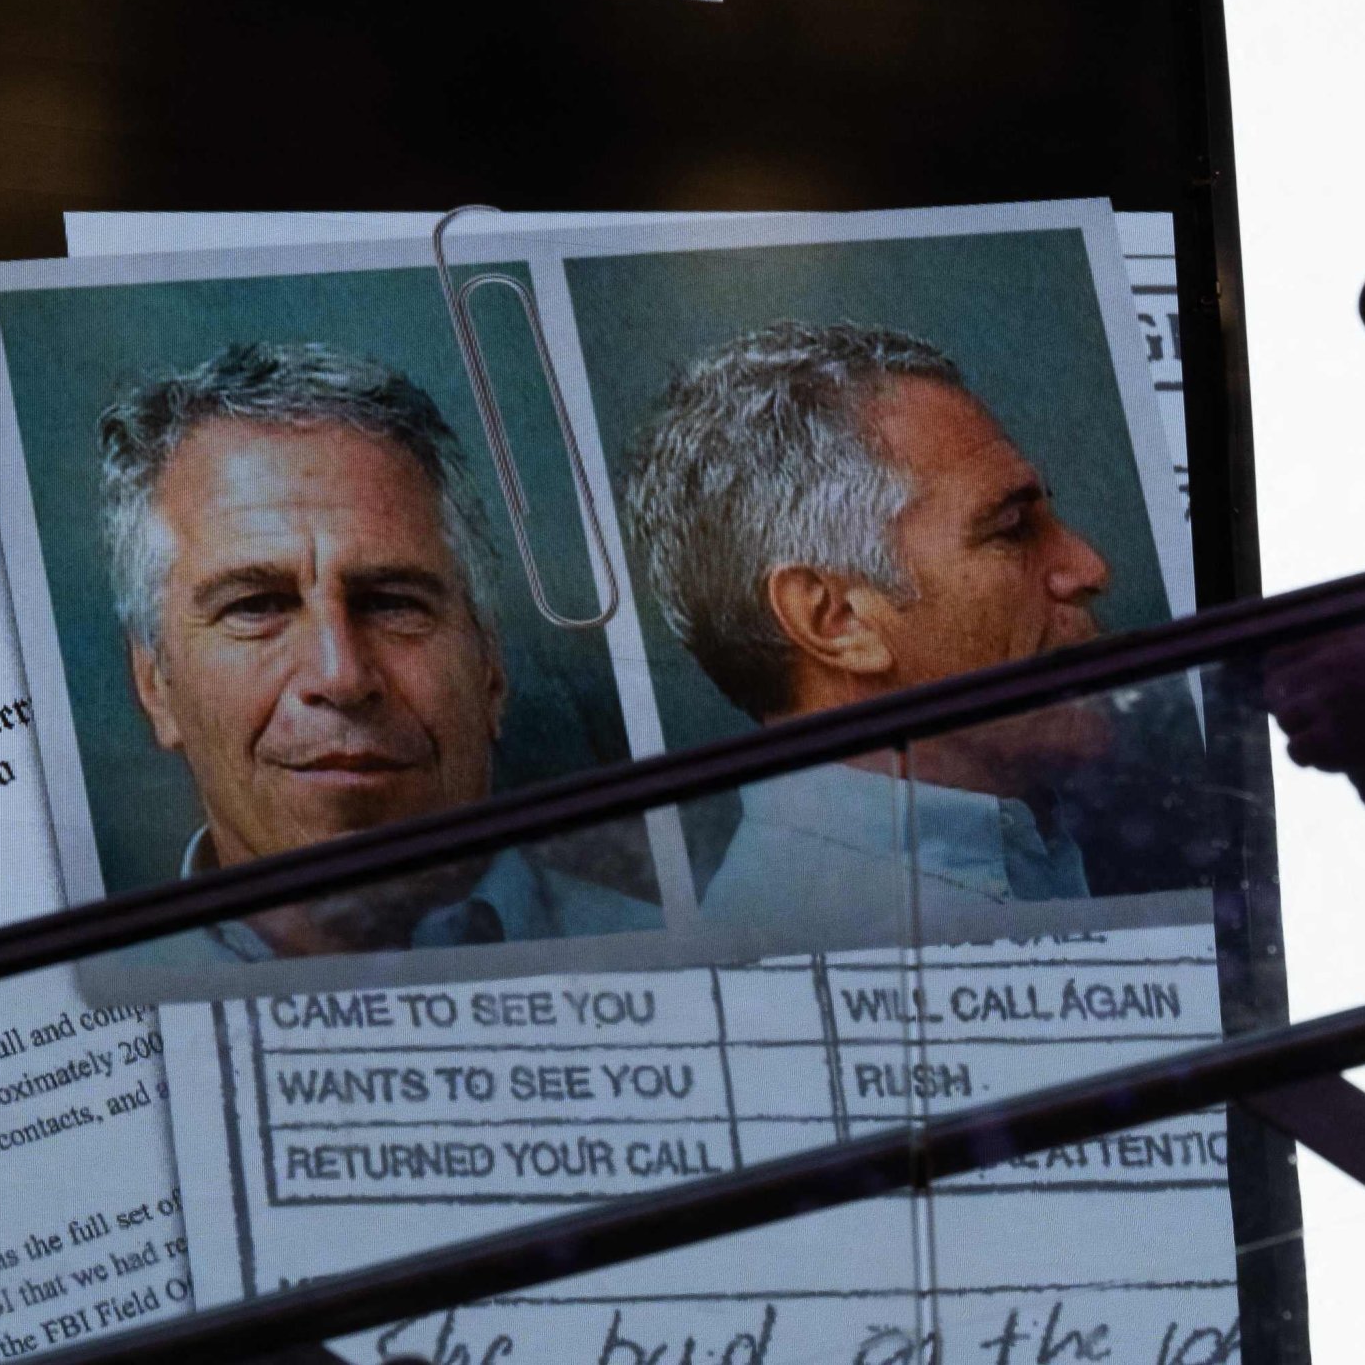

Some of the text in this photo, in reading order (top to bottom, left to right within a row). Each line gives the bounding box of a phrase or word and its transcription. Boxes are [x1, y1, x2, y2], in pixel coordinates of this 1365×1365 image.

[271, 989, 655, 1030] CAME TO SEE YOU
[841, 981, 1182, 1024] WILL CALL AGAIN
[32, 1011, 76, 1048] and
[107, 1079, 152, 1116] and
[278, 1064, 694, 1105] WANTS TO SEE YOU
[854, 1062, 973, 1099] RUSH
[286, 1137, 723, 1181] RETURNED YOUR CALL
[23, 1232, 64, 1262] the
[67, 1212, 111, 1246] full
[116, 1203, 154, 1230] set
[18, 1274, 69, 1309] that
[72, 1264, 109, 1289] we
[109, 1240, 161, 1277] had
[39, 1310, 93, 1345] FBI
[93, 1286, 162, 1328] Field
